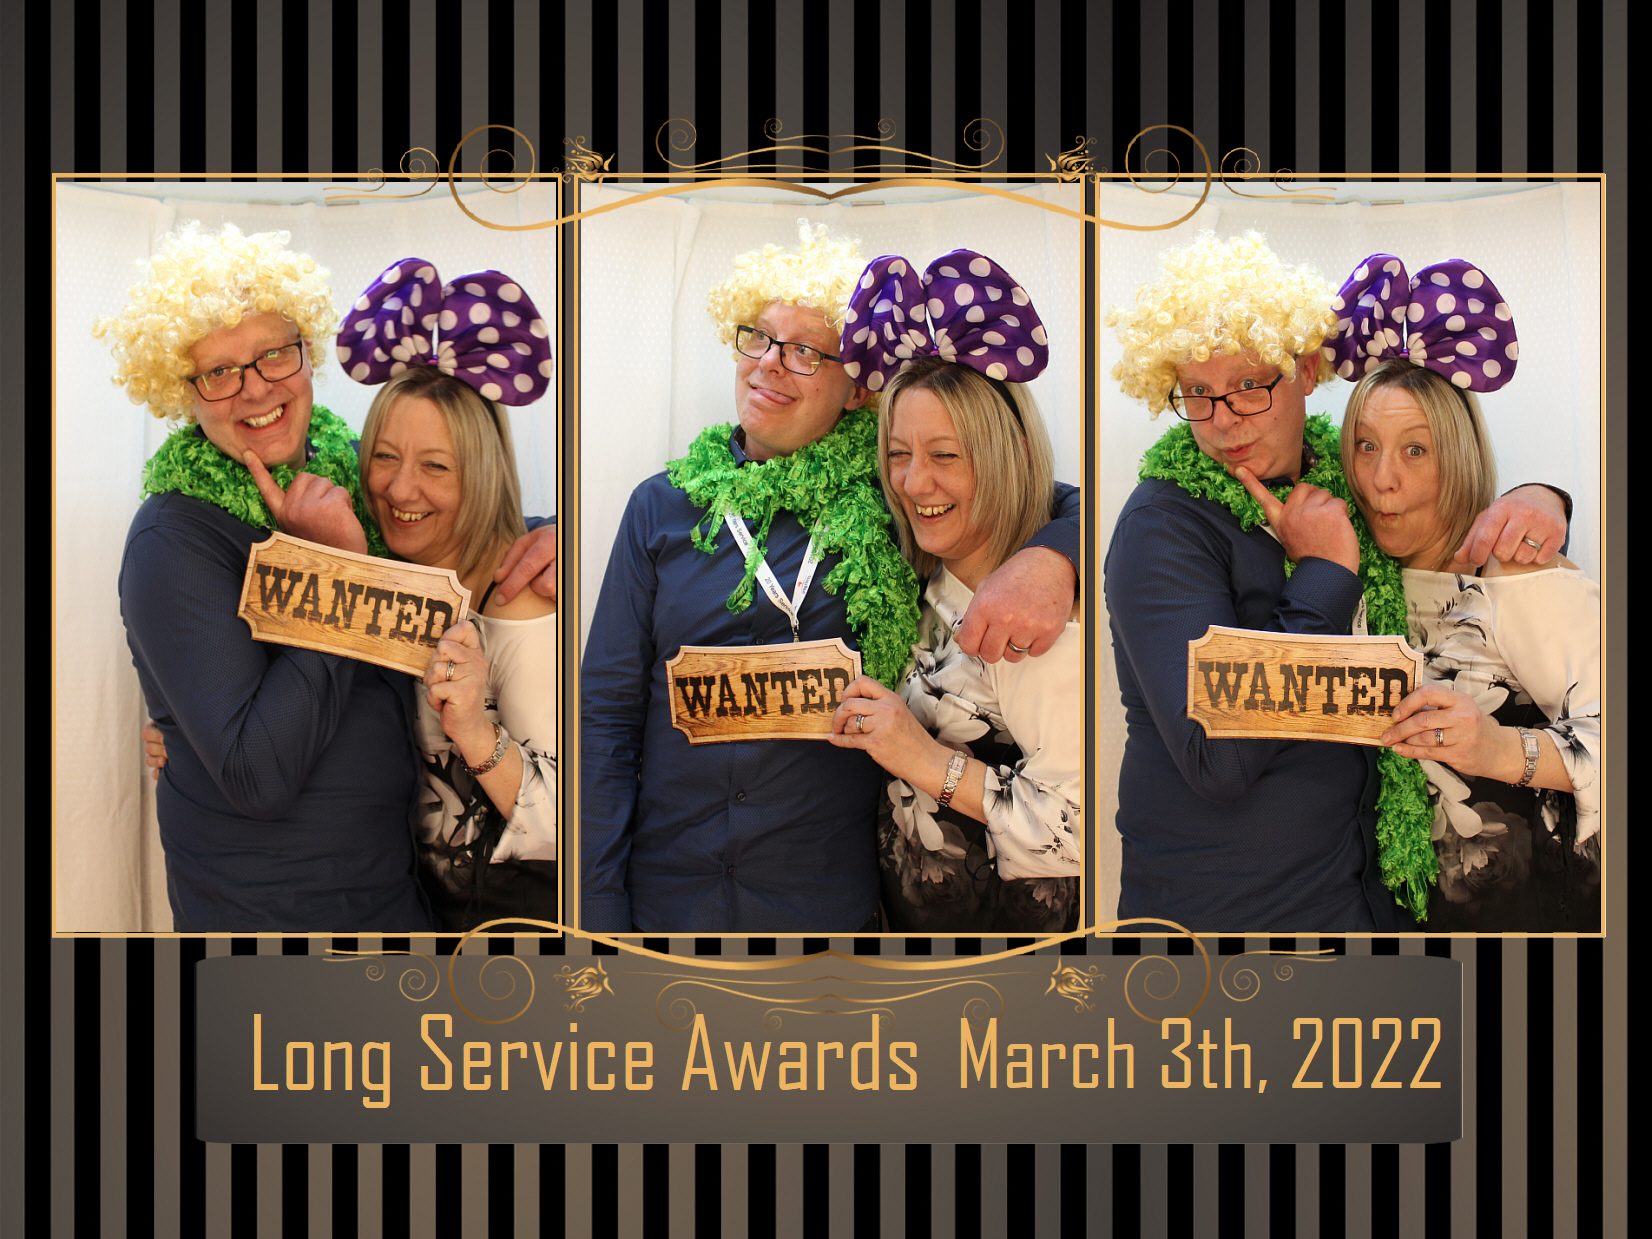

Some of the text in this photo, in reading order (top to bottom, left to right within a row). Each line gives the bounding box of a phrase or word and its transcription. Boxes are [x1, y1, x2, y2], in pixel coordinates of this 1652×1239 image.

[737, 528, 748, 546] Service
[255, 563, 453, 648] WANTED
[764, 577, 794, 617] 20 Years Service
[675, 667, 851, 718] WANTED
[1198, 661, 1408, 717] WANTED
